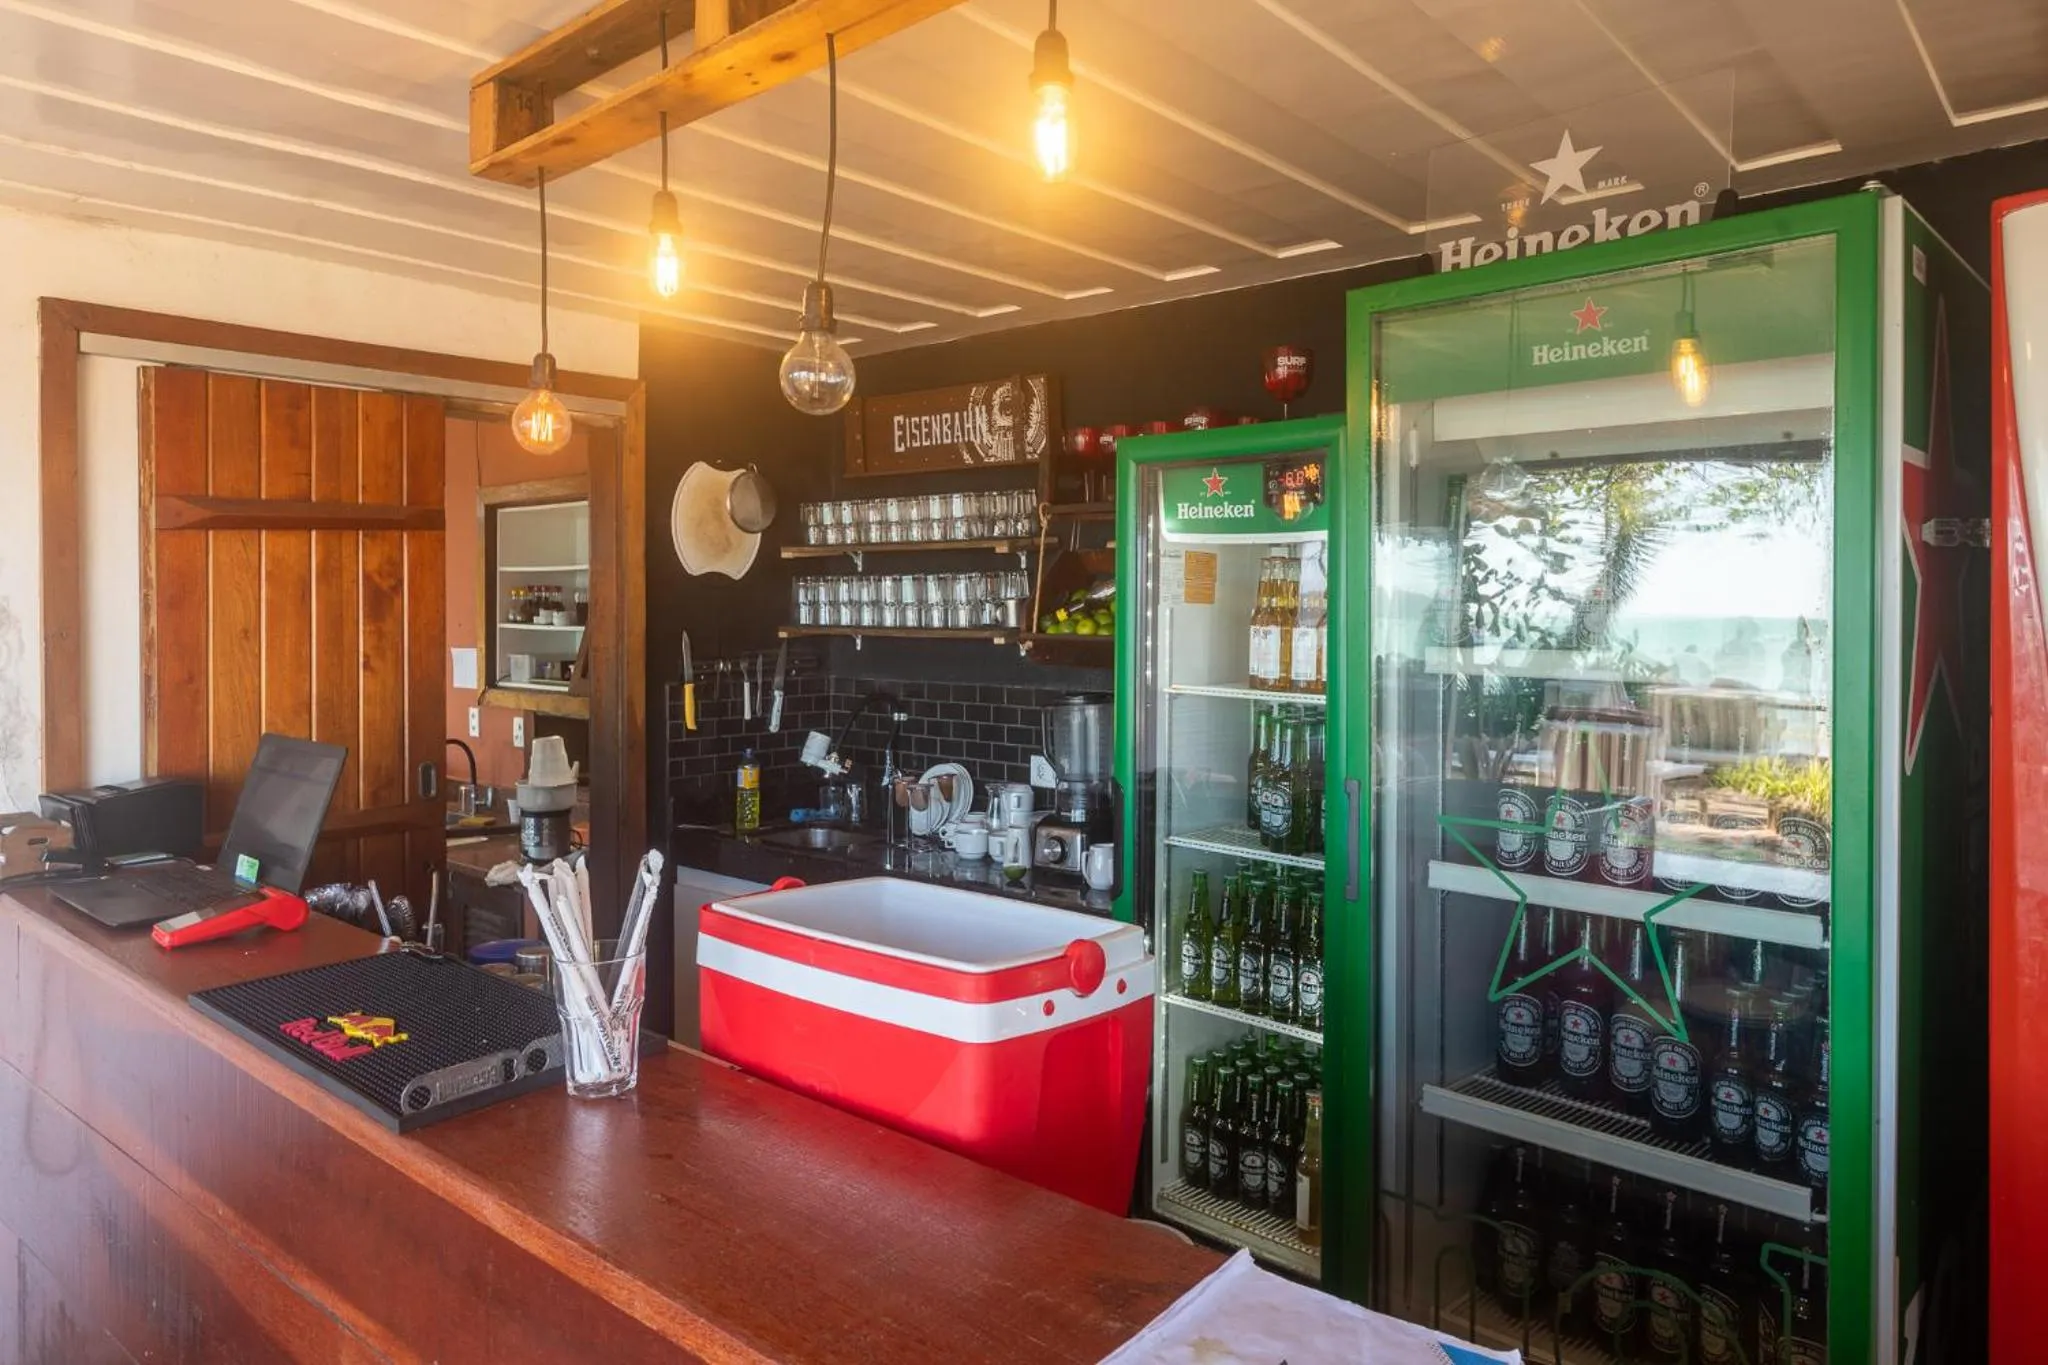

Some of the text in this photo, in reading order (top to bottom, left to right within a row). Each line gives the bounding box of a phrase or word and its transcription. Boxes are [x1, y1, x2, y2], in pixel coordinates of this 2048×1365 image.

[1532, 335, 1650, 366] Heineken
[893, 404, 988, 453] EISENBAHN
[1176, 501, 1254, 519] Heineken
